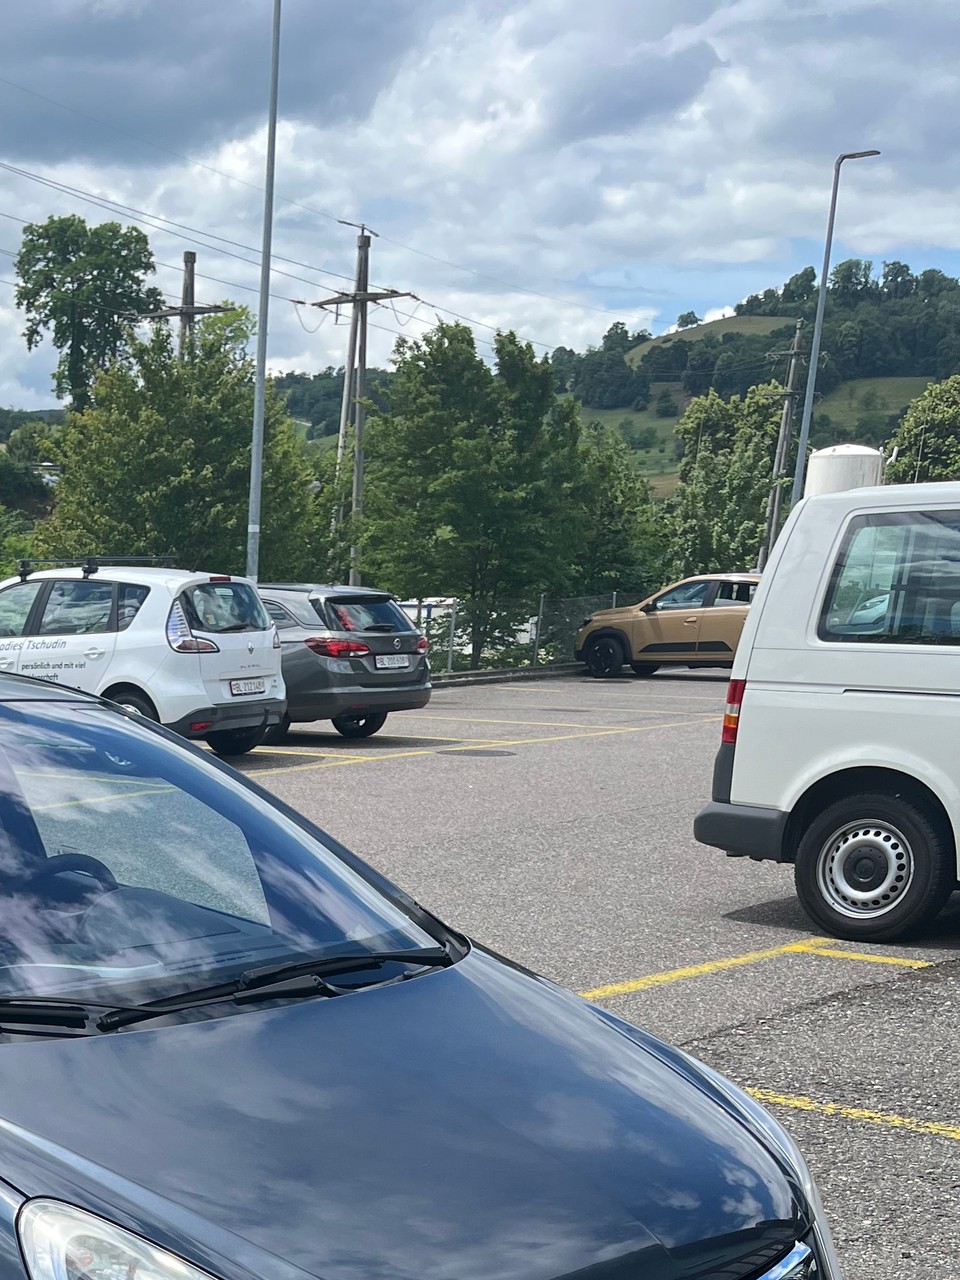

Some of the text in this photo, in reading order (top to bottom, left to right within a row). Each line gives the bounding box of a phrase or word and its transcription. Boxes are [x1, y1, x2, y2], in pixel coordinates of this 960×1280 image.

[26, 638, 67, 650] Tschudin
[21, 661, 86, 671] persönlich und mit viel
